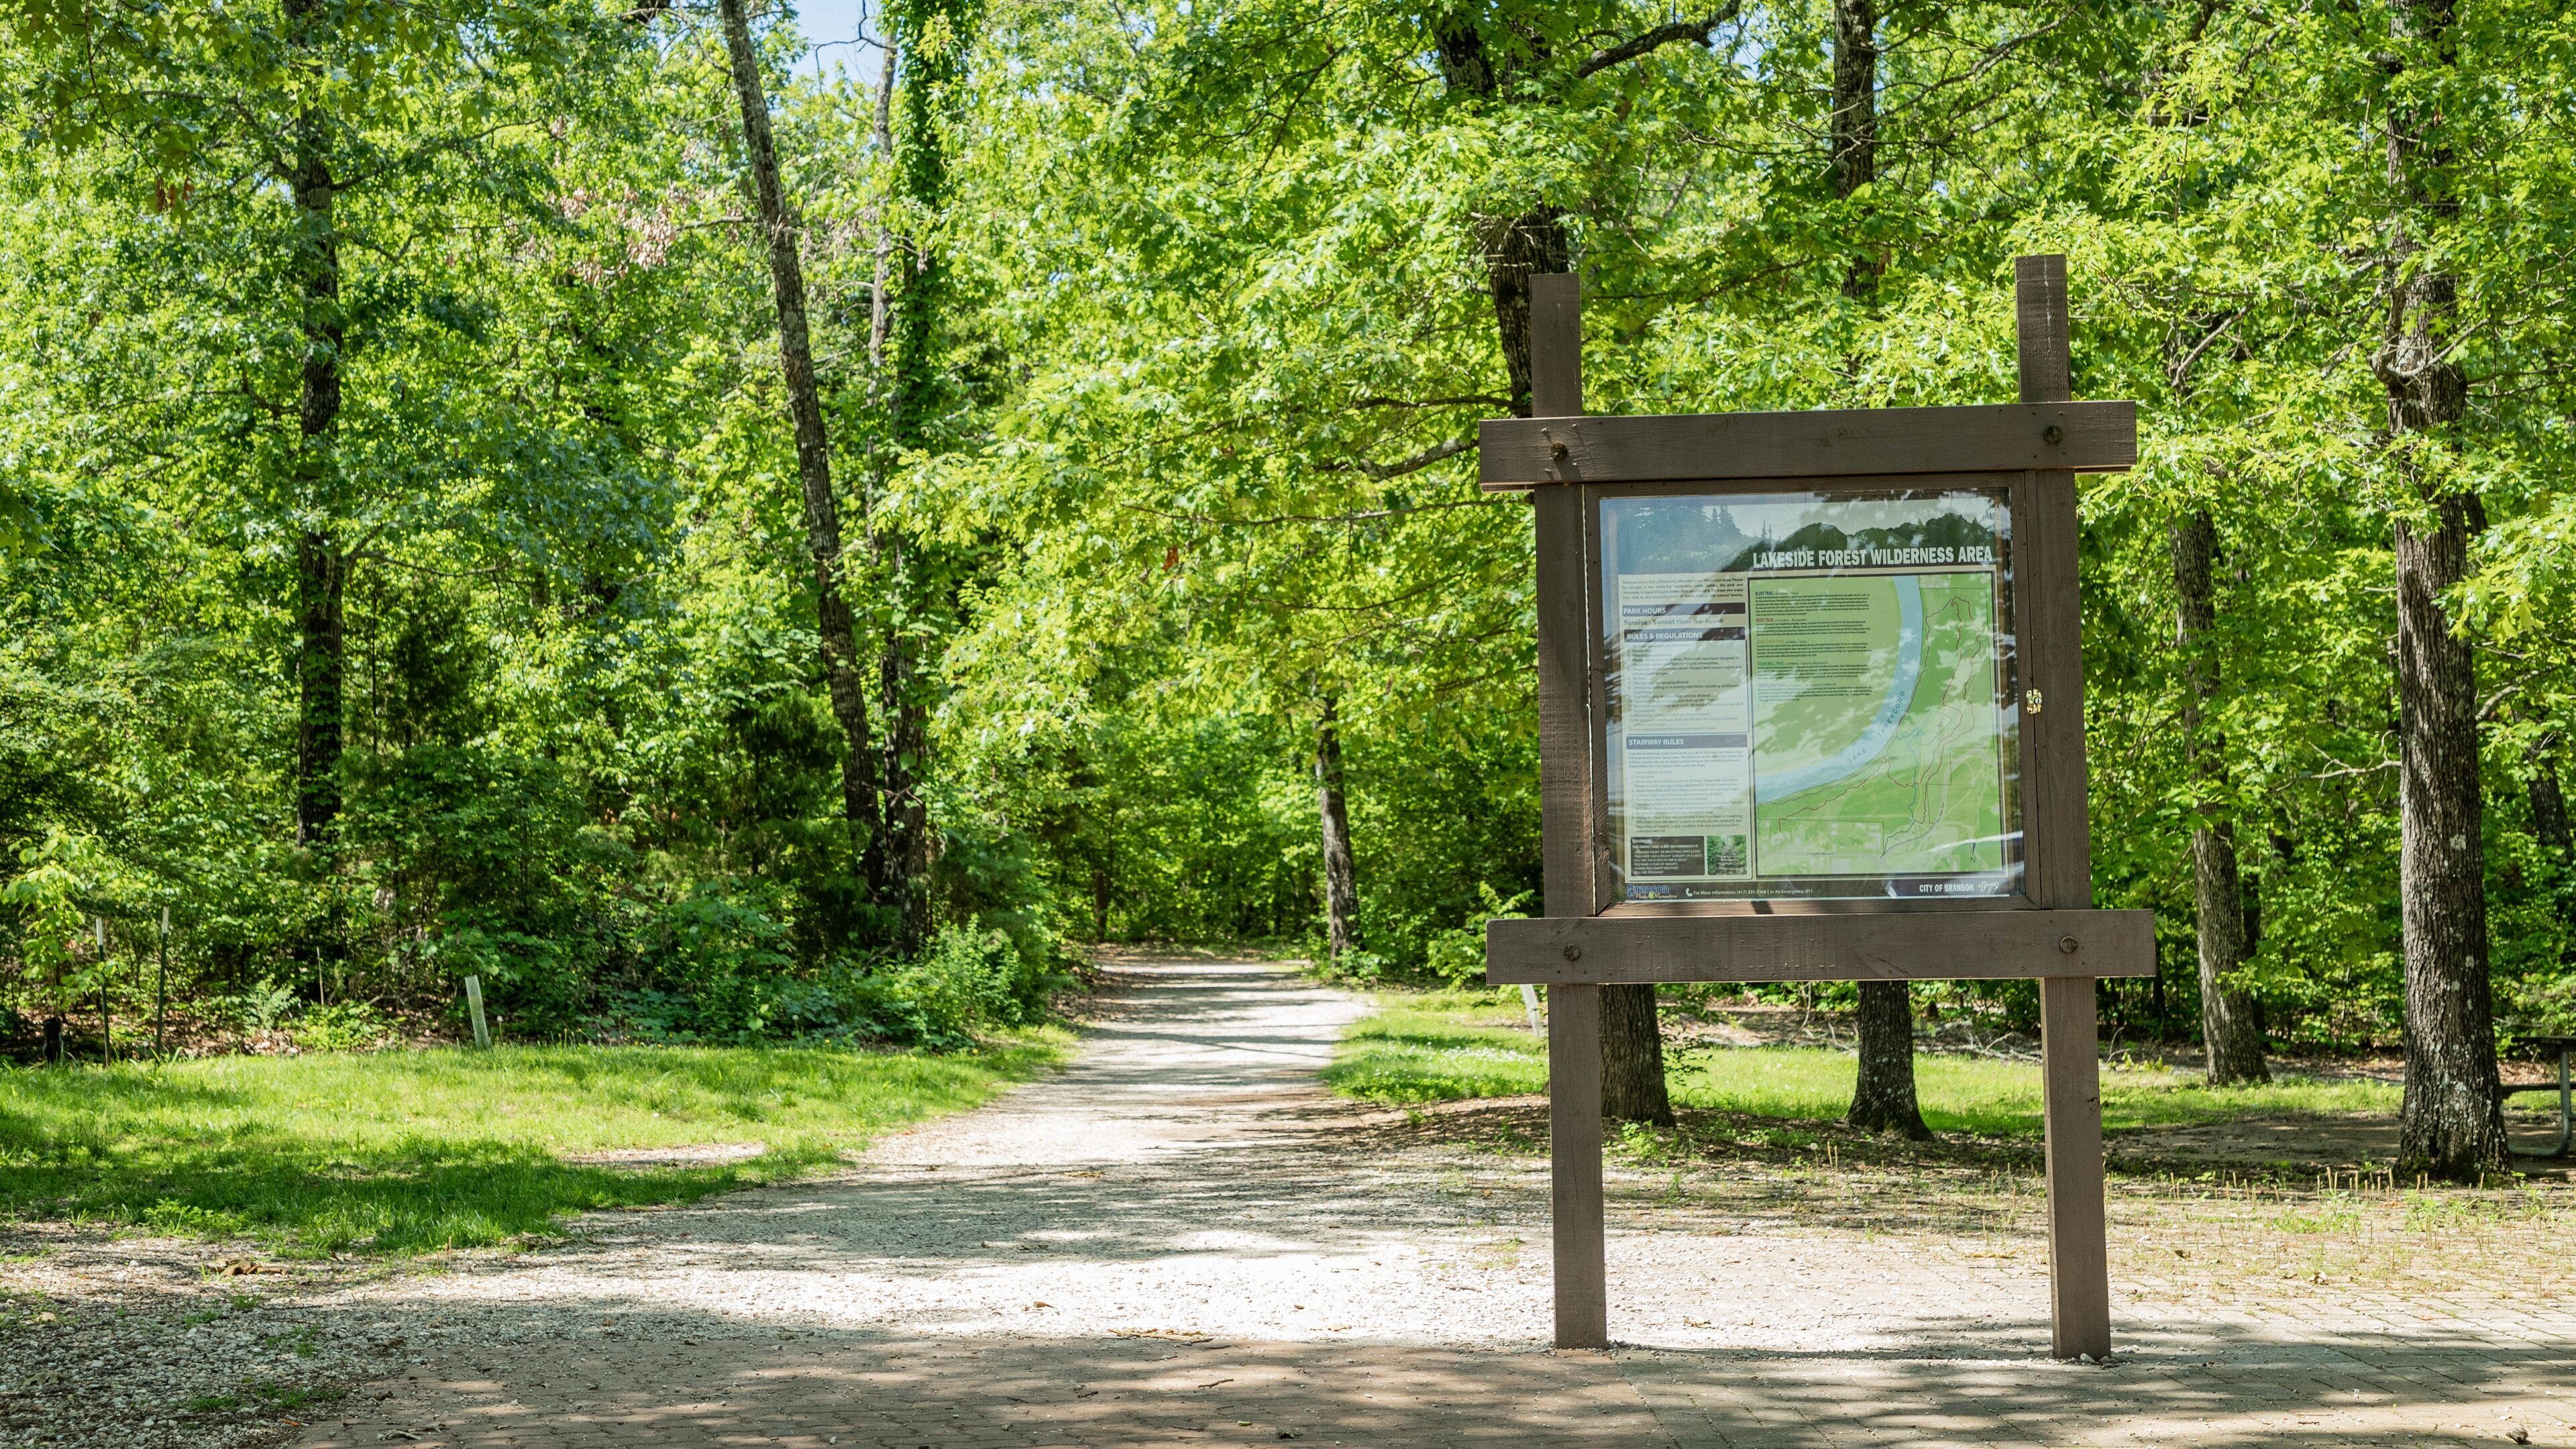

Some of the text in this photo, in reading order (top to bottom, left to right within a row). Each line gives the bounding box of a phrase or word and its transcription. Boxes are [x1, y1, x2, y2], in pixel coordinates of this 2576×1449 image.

[1753, 545, 1993, 568] LAKESIDE FOREST WILDERNESS AREA
[1848, 747, 1867, 763] LAKE
[1878, 691, 1905, 737] TANEYCOMO
[1627, 883, 1669, 897] Branson
[1919, 884, 1933, 892] CITY
[1935, 883, 1943, 892] OF
[1944, 883, 1974, 892] BRANSON
